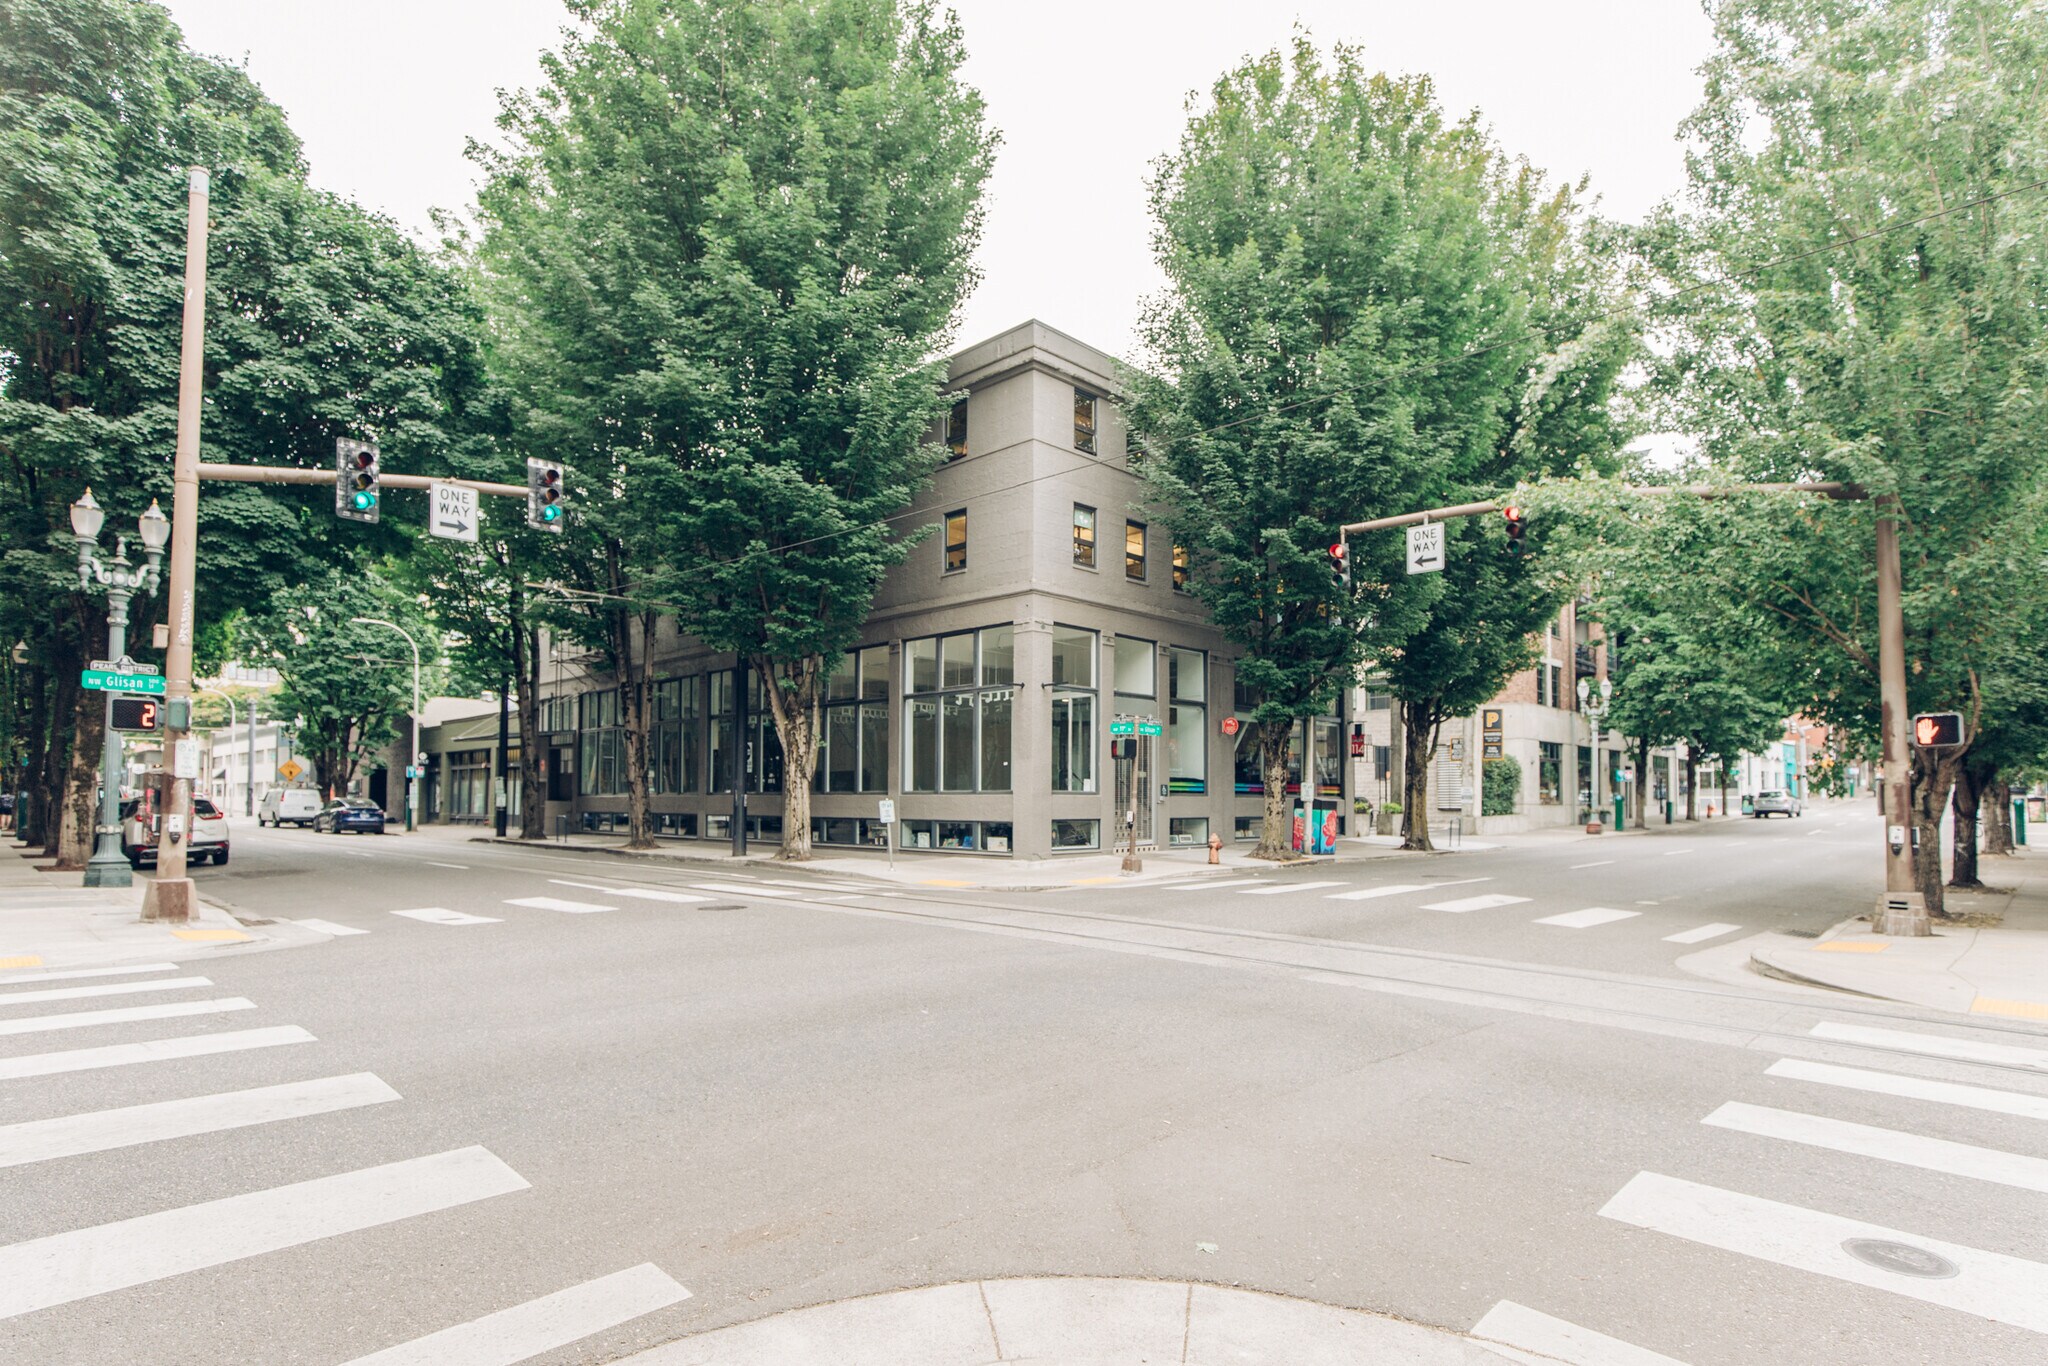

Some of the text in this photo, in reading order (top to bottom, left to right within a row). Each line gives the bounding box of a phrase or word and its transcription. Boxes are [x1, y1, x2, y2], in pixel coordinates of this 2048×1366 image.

[440, 488, 469, 504] ONE
[439, 502, 470, 517] WAY
[1414, 528, 1437, 541] ONE
[1413, 540, 1438, 553] WAY
[106, 675, 143, 688] Glisan
[142, 703, 155, 727] 2
[1487, 711, 1499, 728] P
